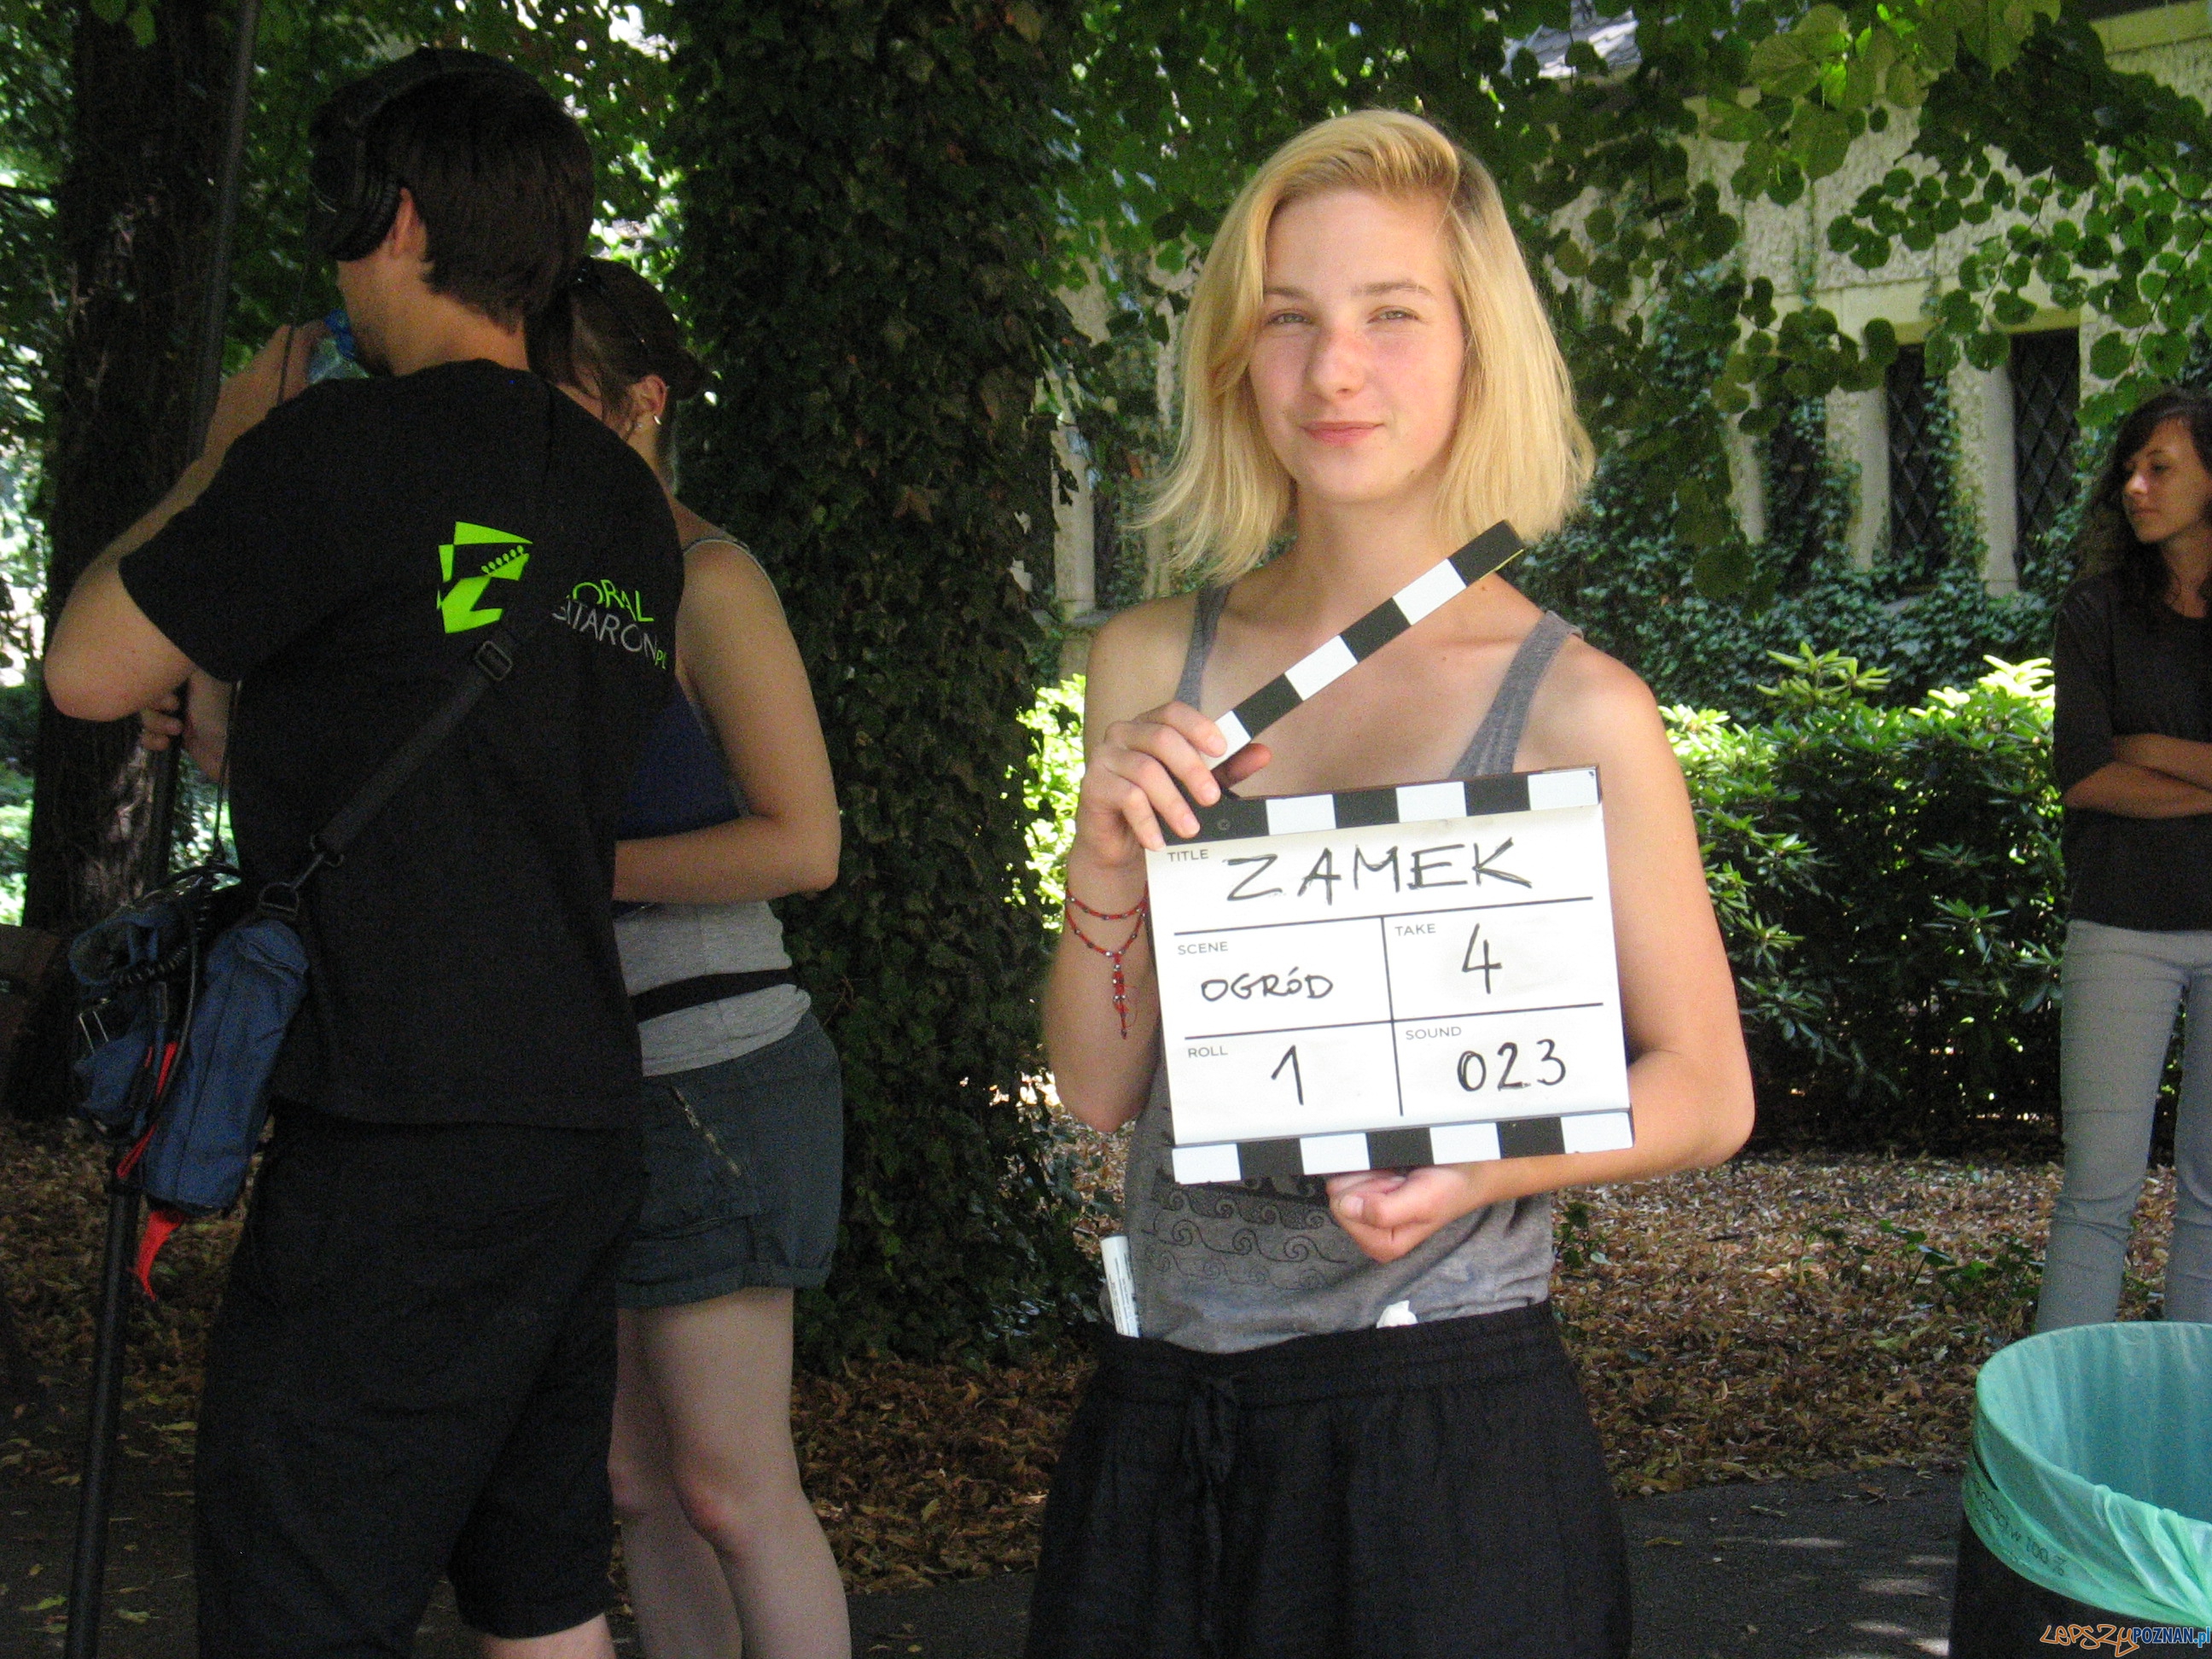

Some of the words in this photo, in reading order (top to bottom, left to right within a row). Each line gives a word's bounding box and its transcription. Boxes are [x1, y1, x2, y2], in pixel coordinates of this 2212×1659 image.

[1167, 847, 1209, 862] TITLE
[1222, 837, 1533, 905] ZAMEK
[1394, 923, 1436, 936] TAKE
[1177, 941, 1229, 955] SCENE
[1462, 923, 1502, 994] 4
[1405, 1025, 1462, 1040] SOUND
[1187, 1045, 1229, 1058] ROLL
[1457, 1039, 1567, 1091] 023
[1271, 1045, 1304, 1105] 1
